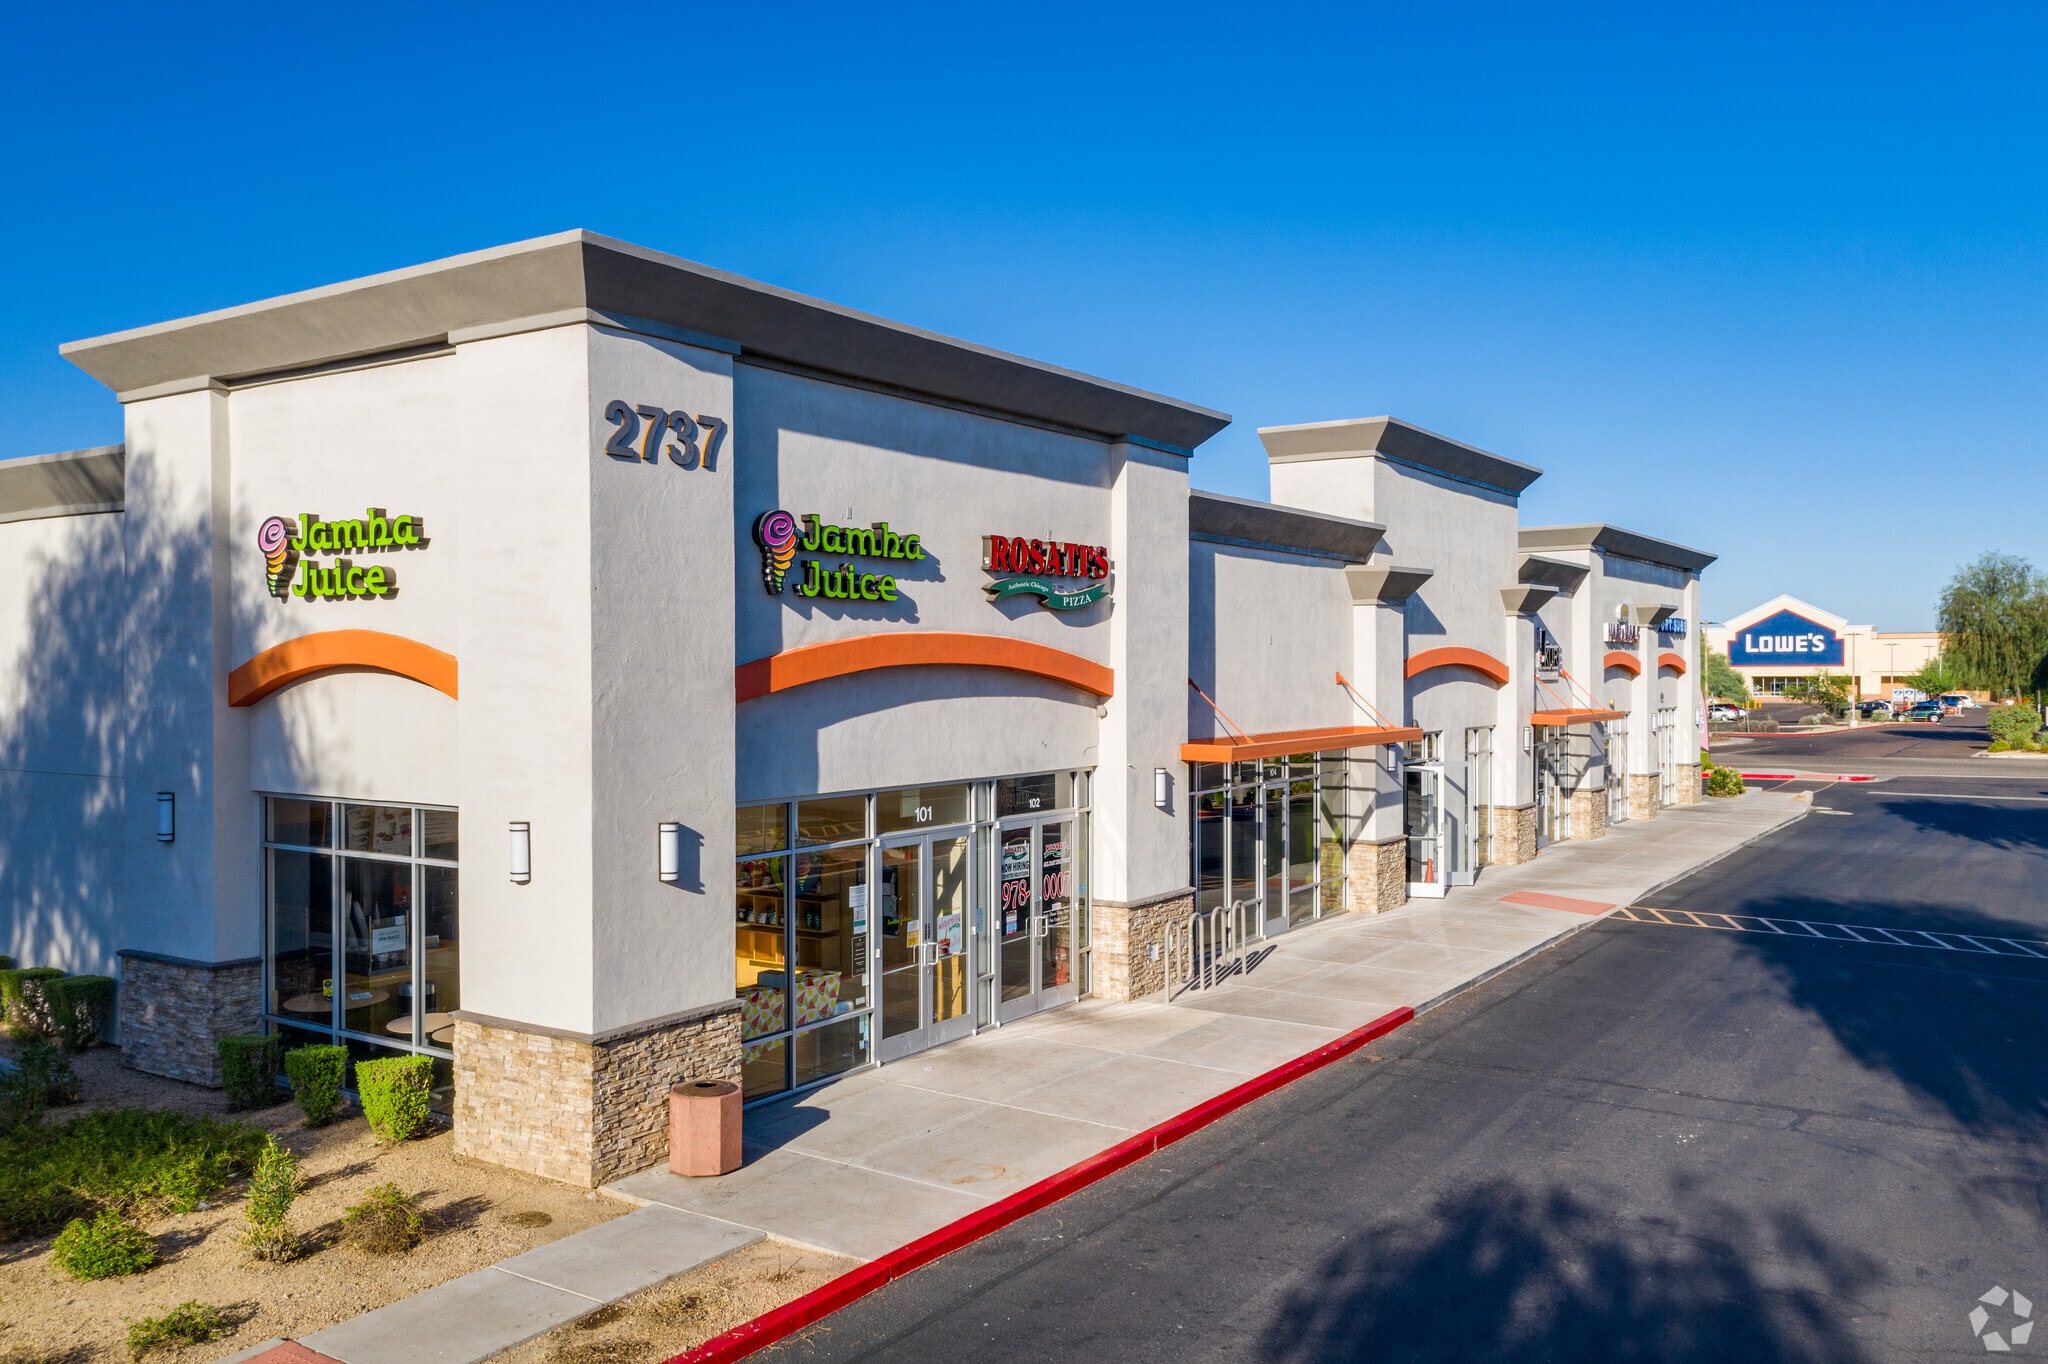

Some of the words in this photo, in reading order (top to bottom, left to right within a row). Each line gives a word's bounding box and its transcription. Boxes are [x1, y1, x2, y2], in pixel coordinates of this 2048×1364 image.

[605, 400, 724, 468] 2737
[292, 508, 420, 552] Jamba
[801, 514, 926, 560] Jamba
[989, 535, 1109, 579] ROSATI'S
[292, 558, 389, 598] Juice
[801, 560, 899, 601] Juice
[1063, 594, 1092, 607] PIZZA
[1745, 632, 1826, 653] LOWE'S
[914, 806, 934, 823] 101
[1029, 797, 1041, 809] 102
[1001, 862, 1013, 874] NOW
